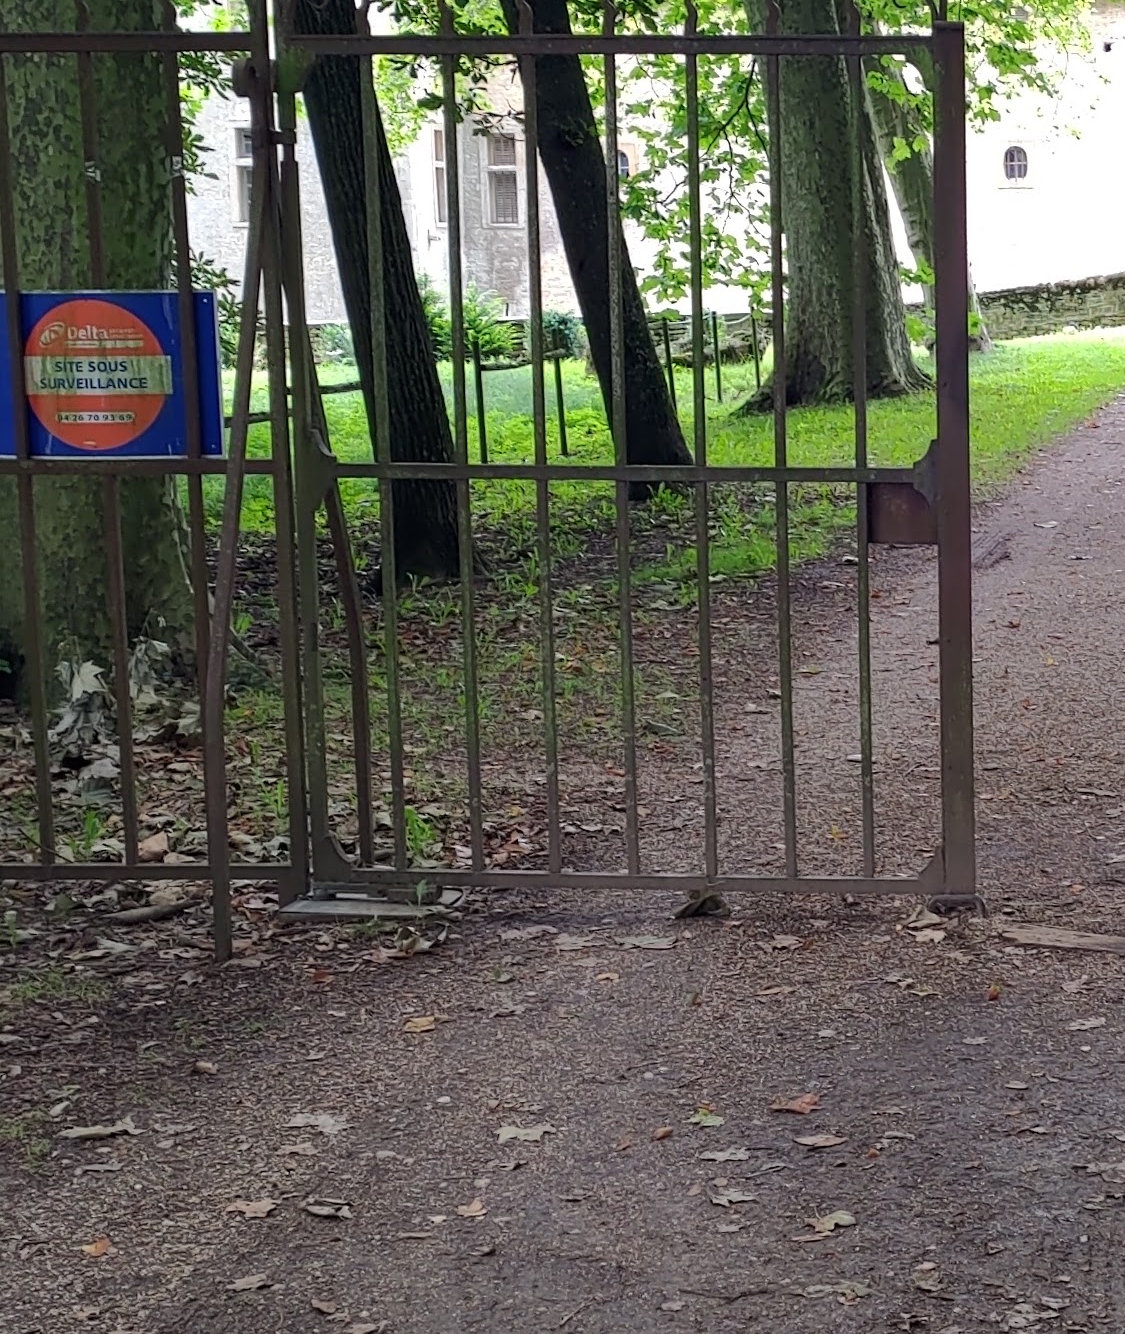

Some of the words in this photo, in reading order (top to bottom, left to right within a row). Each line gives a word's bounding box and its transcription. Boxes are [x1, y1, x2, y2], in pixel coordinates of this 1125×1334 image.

[68, 325, 108, 339] Delta
[54, 362, 83, 372] SITE
[88, 360, 128, 372] SOUS
[40, 377, 148, 389] SURVEILLANCE
